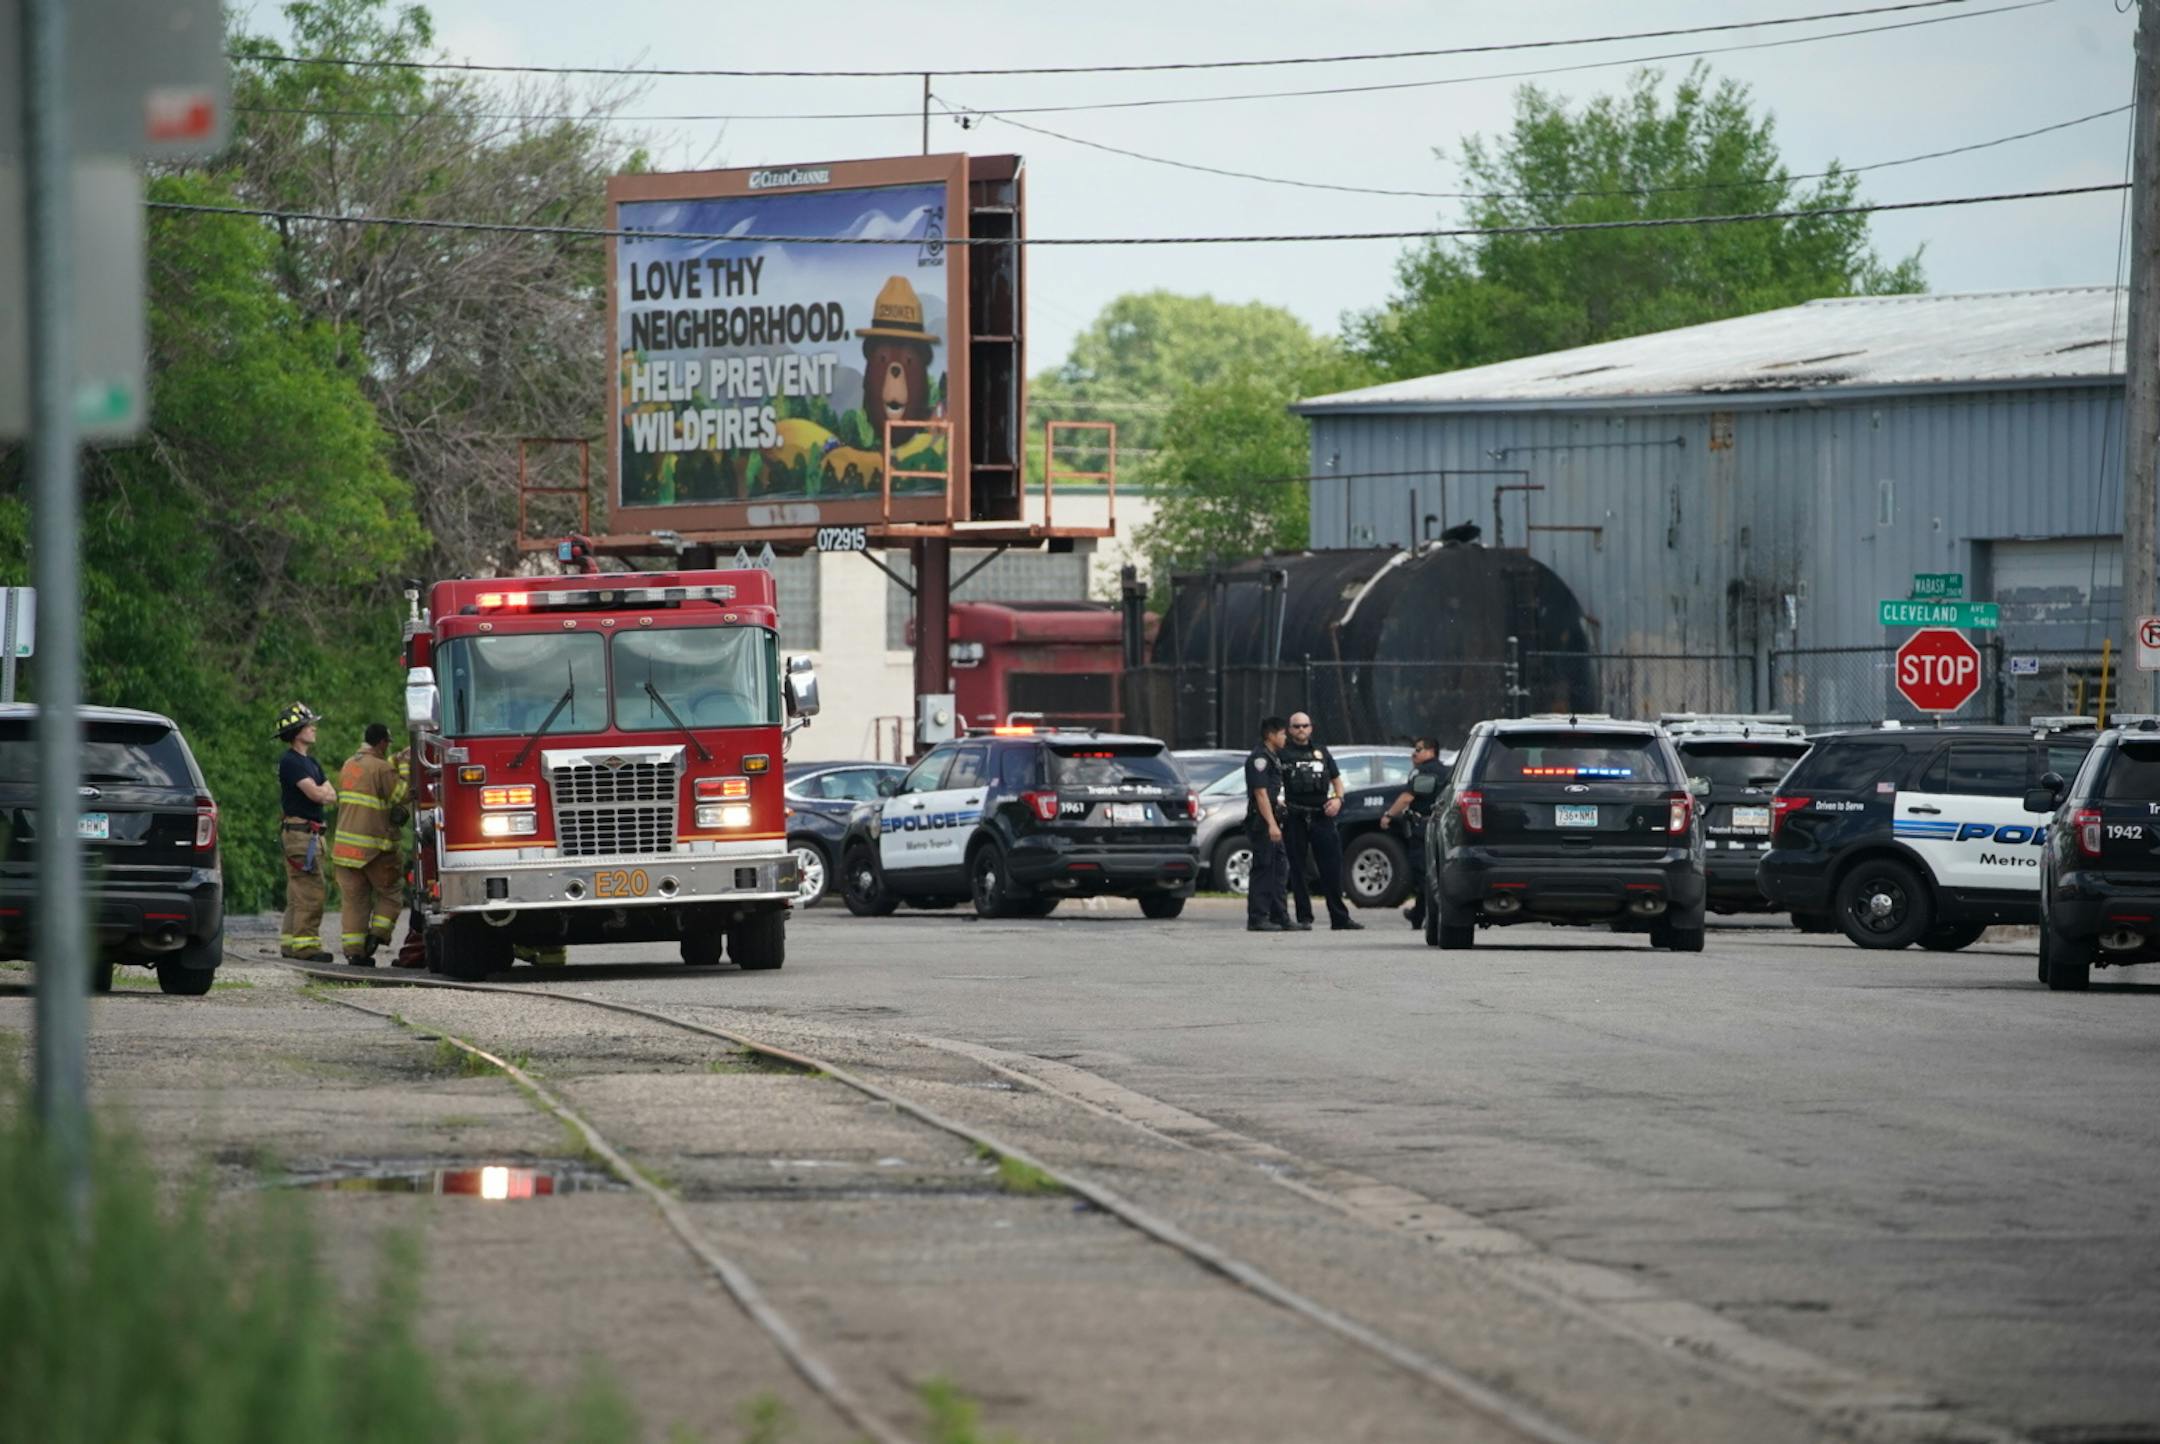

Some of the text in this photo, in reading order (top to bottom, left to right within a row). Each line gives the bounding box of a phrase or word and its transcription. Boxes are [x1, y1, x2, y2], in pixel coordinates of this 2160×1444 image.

[631, 257, 764, 302] LOVE THY
[631, 302, 850, 352] NEIGHBORHOOD.
[631, 353, 838, 403] HELP PREVENT
[631, 405, 784, 453] WILDFIRES.
[817, 528, 866, 551] 072915
[1915, 578, 1945, 593] WABASH
[1883, 604, 1984, 622] CLEVELAND AVE
[1902, 654, 1974, 686] STOP
[1087, 785, 1162, 795] Transit Police
[1061, 802, 1084, 813] 1961
[1816, 800, 1836, 810] Driven
[1845, 801, 1864, 811] Serve
[892, 812, 957, 832] POLICE
[2107, 825, 2142, 839] 1942
[1980, 853, 2037, 867] Metro
[595, 869, 648, 897] E20
